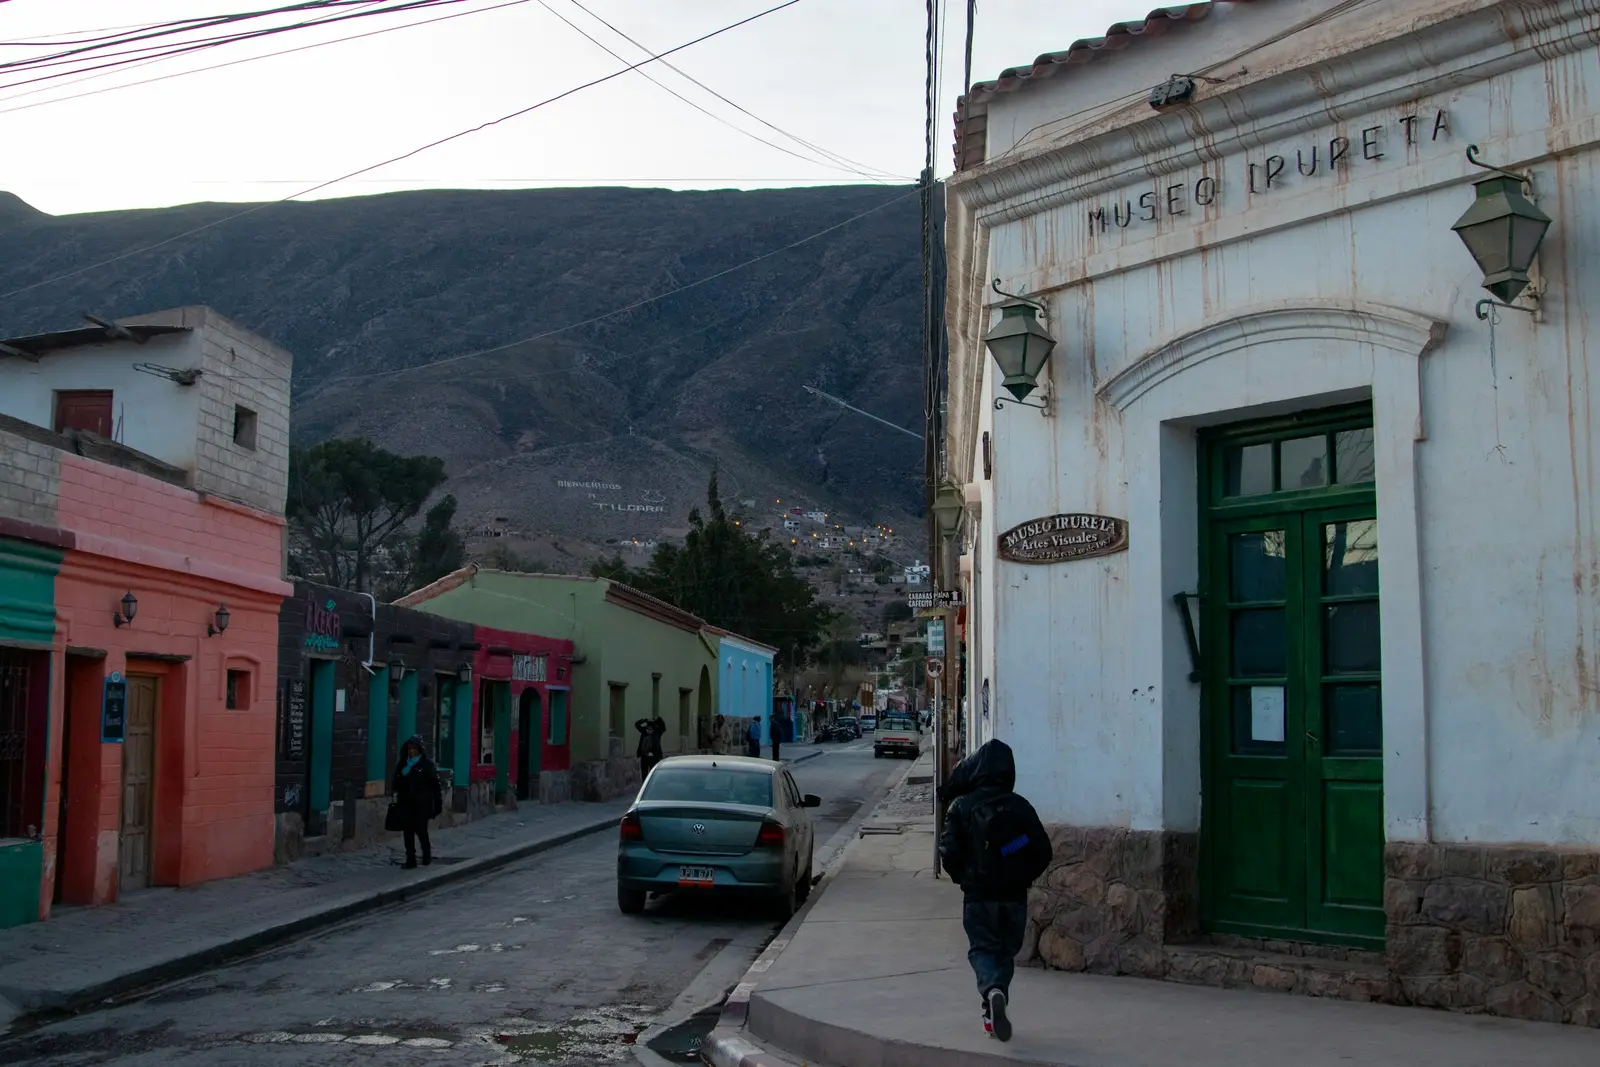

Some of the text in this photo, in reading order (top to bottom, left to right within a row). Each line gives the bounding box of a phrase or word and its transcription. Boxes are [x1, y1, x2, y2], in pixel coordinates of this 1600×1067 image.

[1088, 108, 1451, 238] MUSEO IRURETA
[592, 502, 664, 512] TILCARA
[1005, 515, 1116, 548] MUSEO IRURETA
[1021, 531, 1098, 551] Artes Visuales
